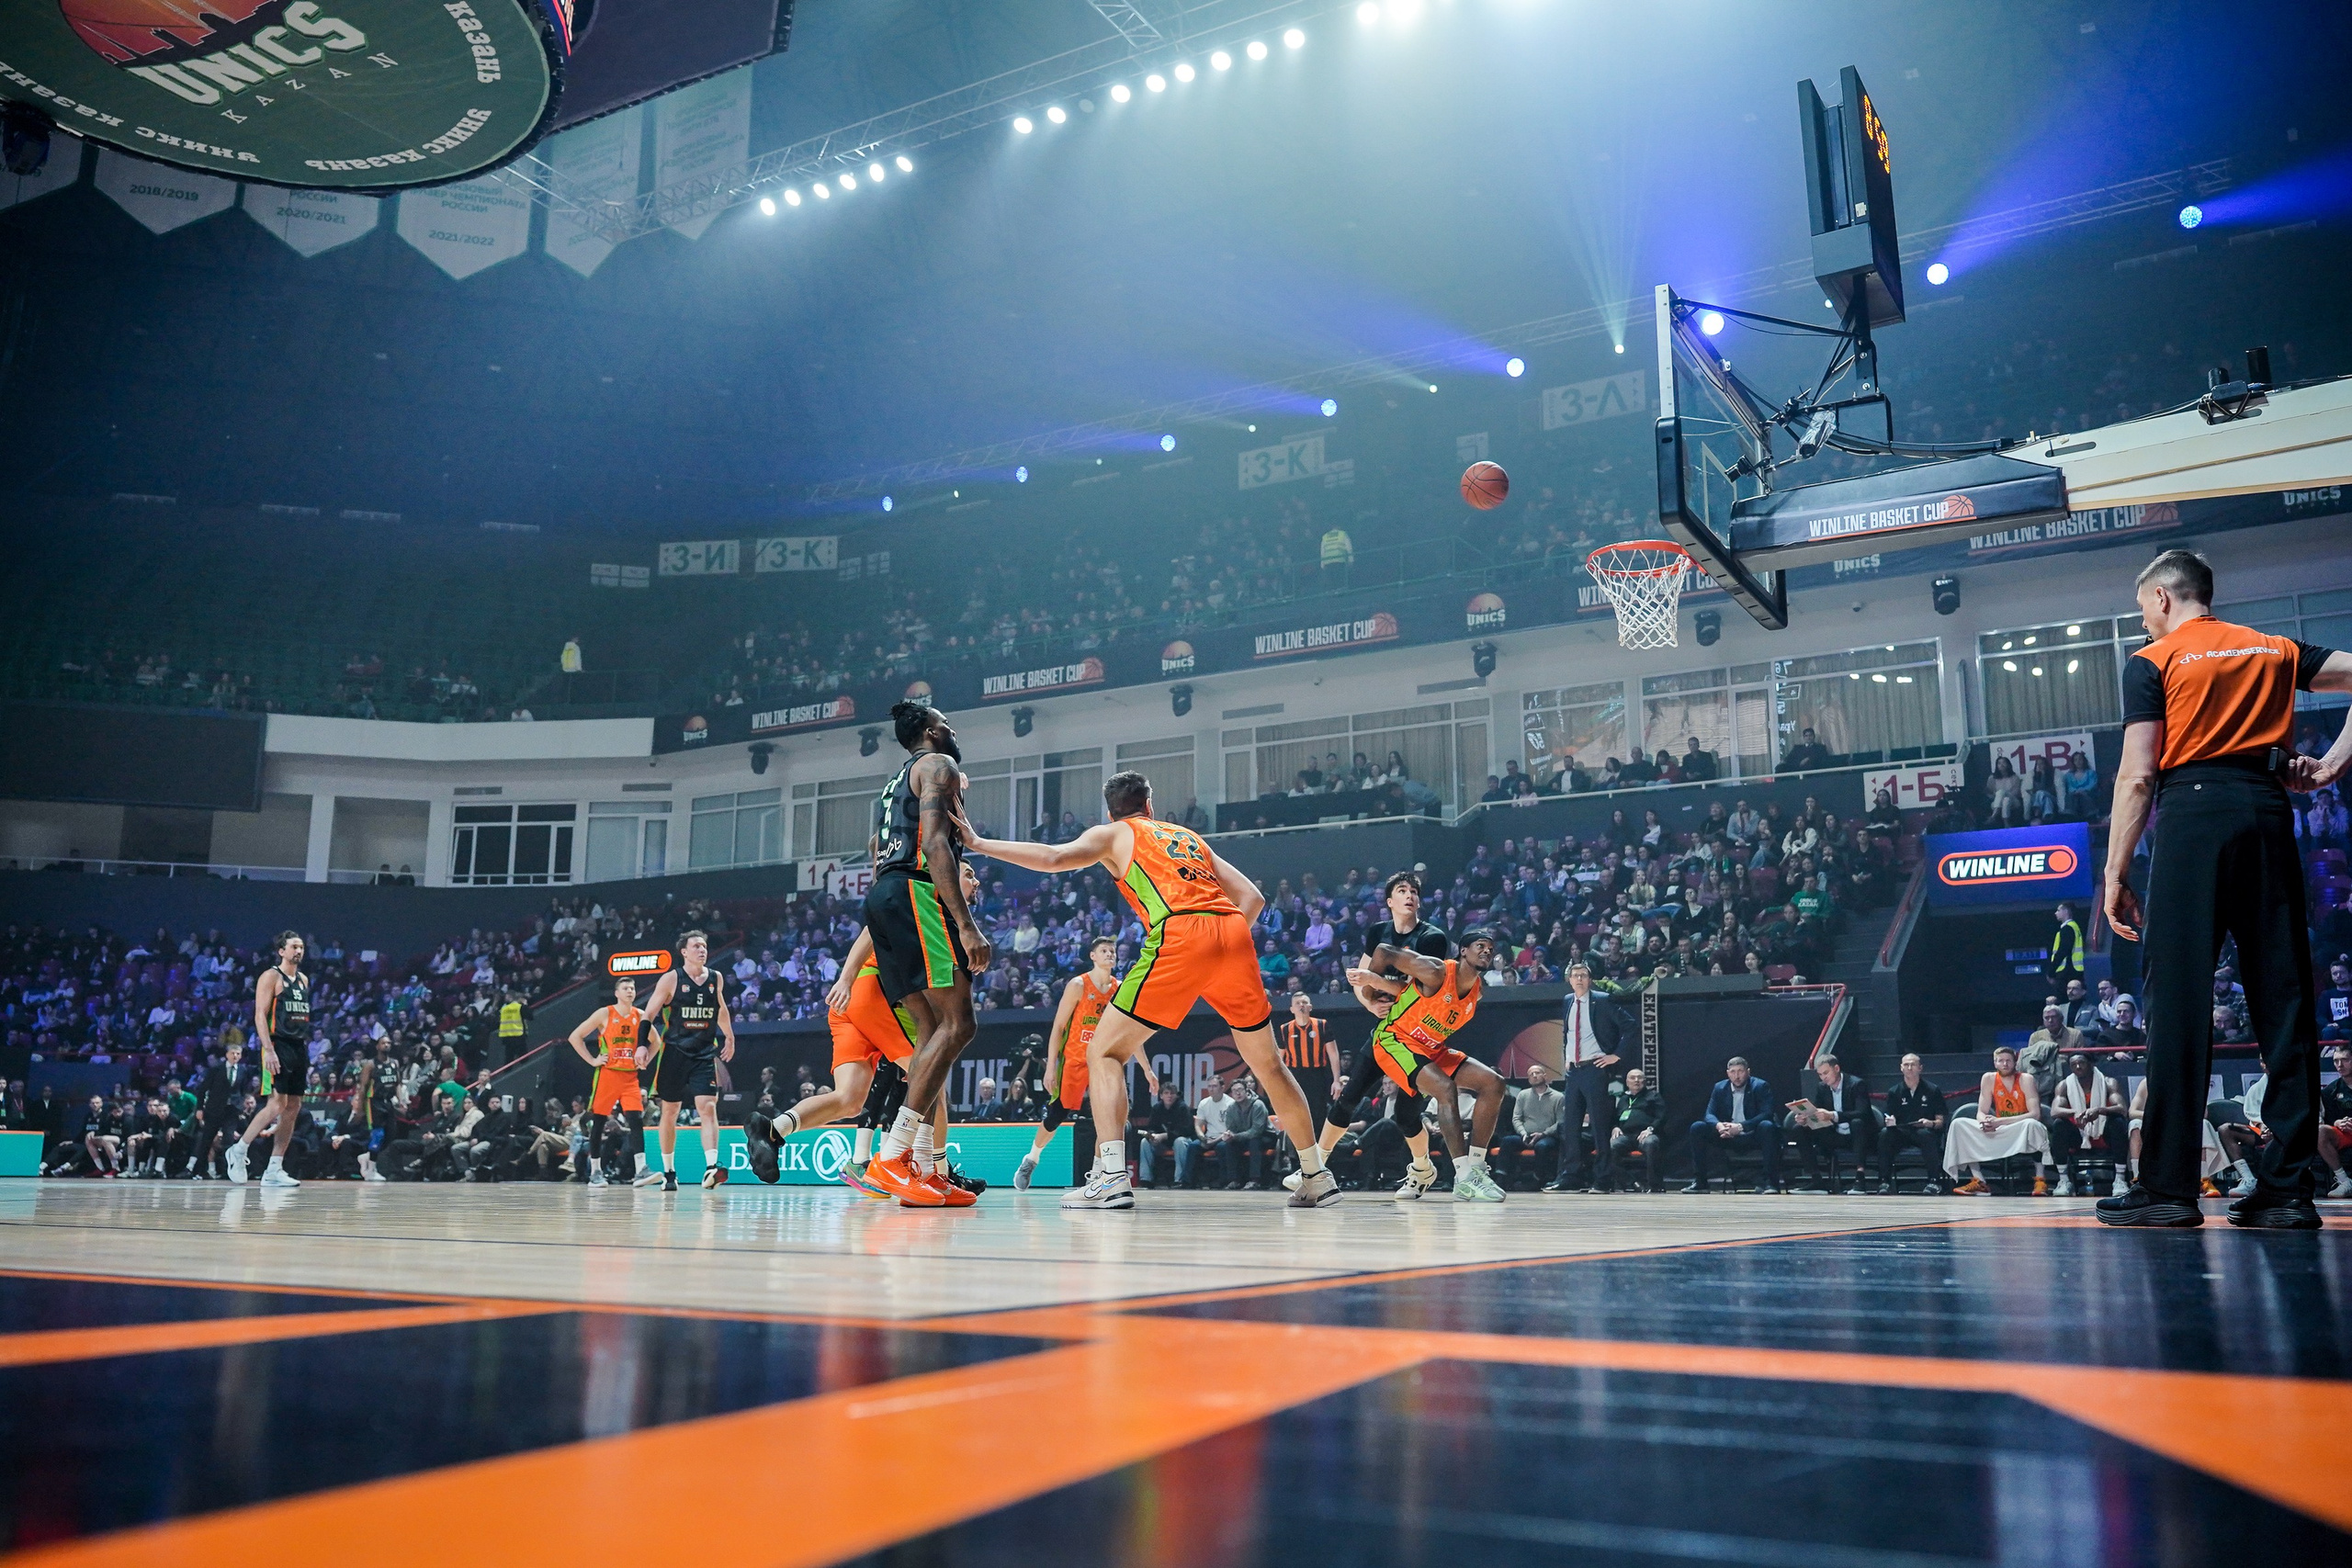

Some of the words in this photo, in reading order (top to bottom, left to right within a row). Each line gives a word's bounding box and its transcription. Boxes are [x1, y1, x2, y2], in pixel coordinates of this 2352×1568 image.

[123, 1, 367, 107] UNICS
[220, 52, 399, 125] KAZAN
[130, 185, 199, 202] 2018/2019
[2282, 486, 2342, 506] UNICS
[1809, 513, 1867, 537] WINLINE
[1870, 505, 1920, 529] BASKET
[1923, 501, 1950, 522] CUP
[2045, 506, 2108, 539] BASKET
[2113, 503, 2146, 530] CUP
[1834, 553, 1881, 573] UNICS
[1466, 608, 1507, 626] UNICS
[1255, 630, 1305, 655] WINLINE
[1307, 623, 1351, 647] BASKET
[1353, 618, 1376, 640] CUP
[1161, 655, 1195, 671] UNICS
[2206, 646, 2281, 659] ACADEMSERVICE
[983, 671, 1025, 695] WINLINE
[1027, 665, 1065, 688] BASKET
[1066, 662, 1087, 683] CUP
[752, 710, 789, 729] WINLINE
[789, 704, 822, 725] BASKET
[822, 701, 840, 718] CUP
[1883, 770, 1946, 806] 1-Б
[1153, 830, 1205, 863] 22
[1949, 853, 2045, 879] WINLINE
[612, 955, 659, 972] WINLINE
[285, 1000, 311, 1013] UNICS
[696, 993, 704, 1005] 5
[682, 1007, 714, 1019] UNICS
[1445, 1010, 1460, 1025] 15
[1644, 993, 1657, 1091] ЕКАТЕРИНБ
[1151, 1053, 1215, 1110] CUP
[729, 1143, 809, 1171] БНК
